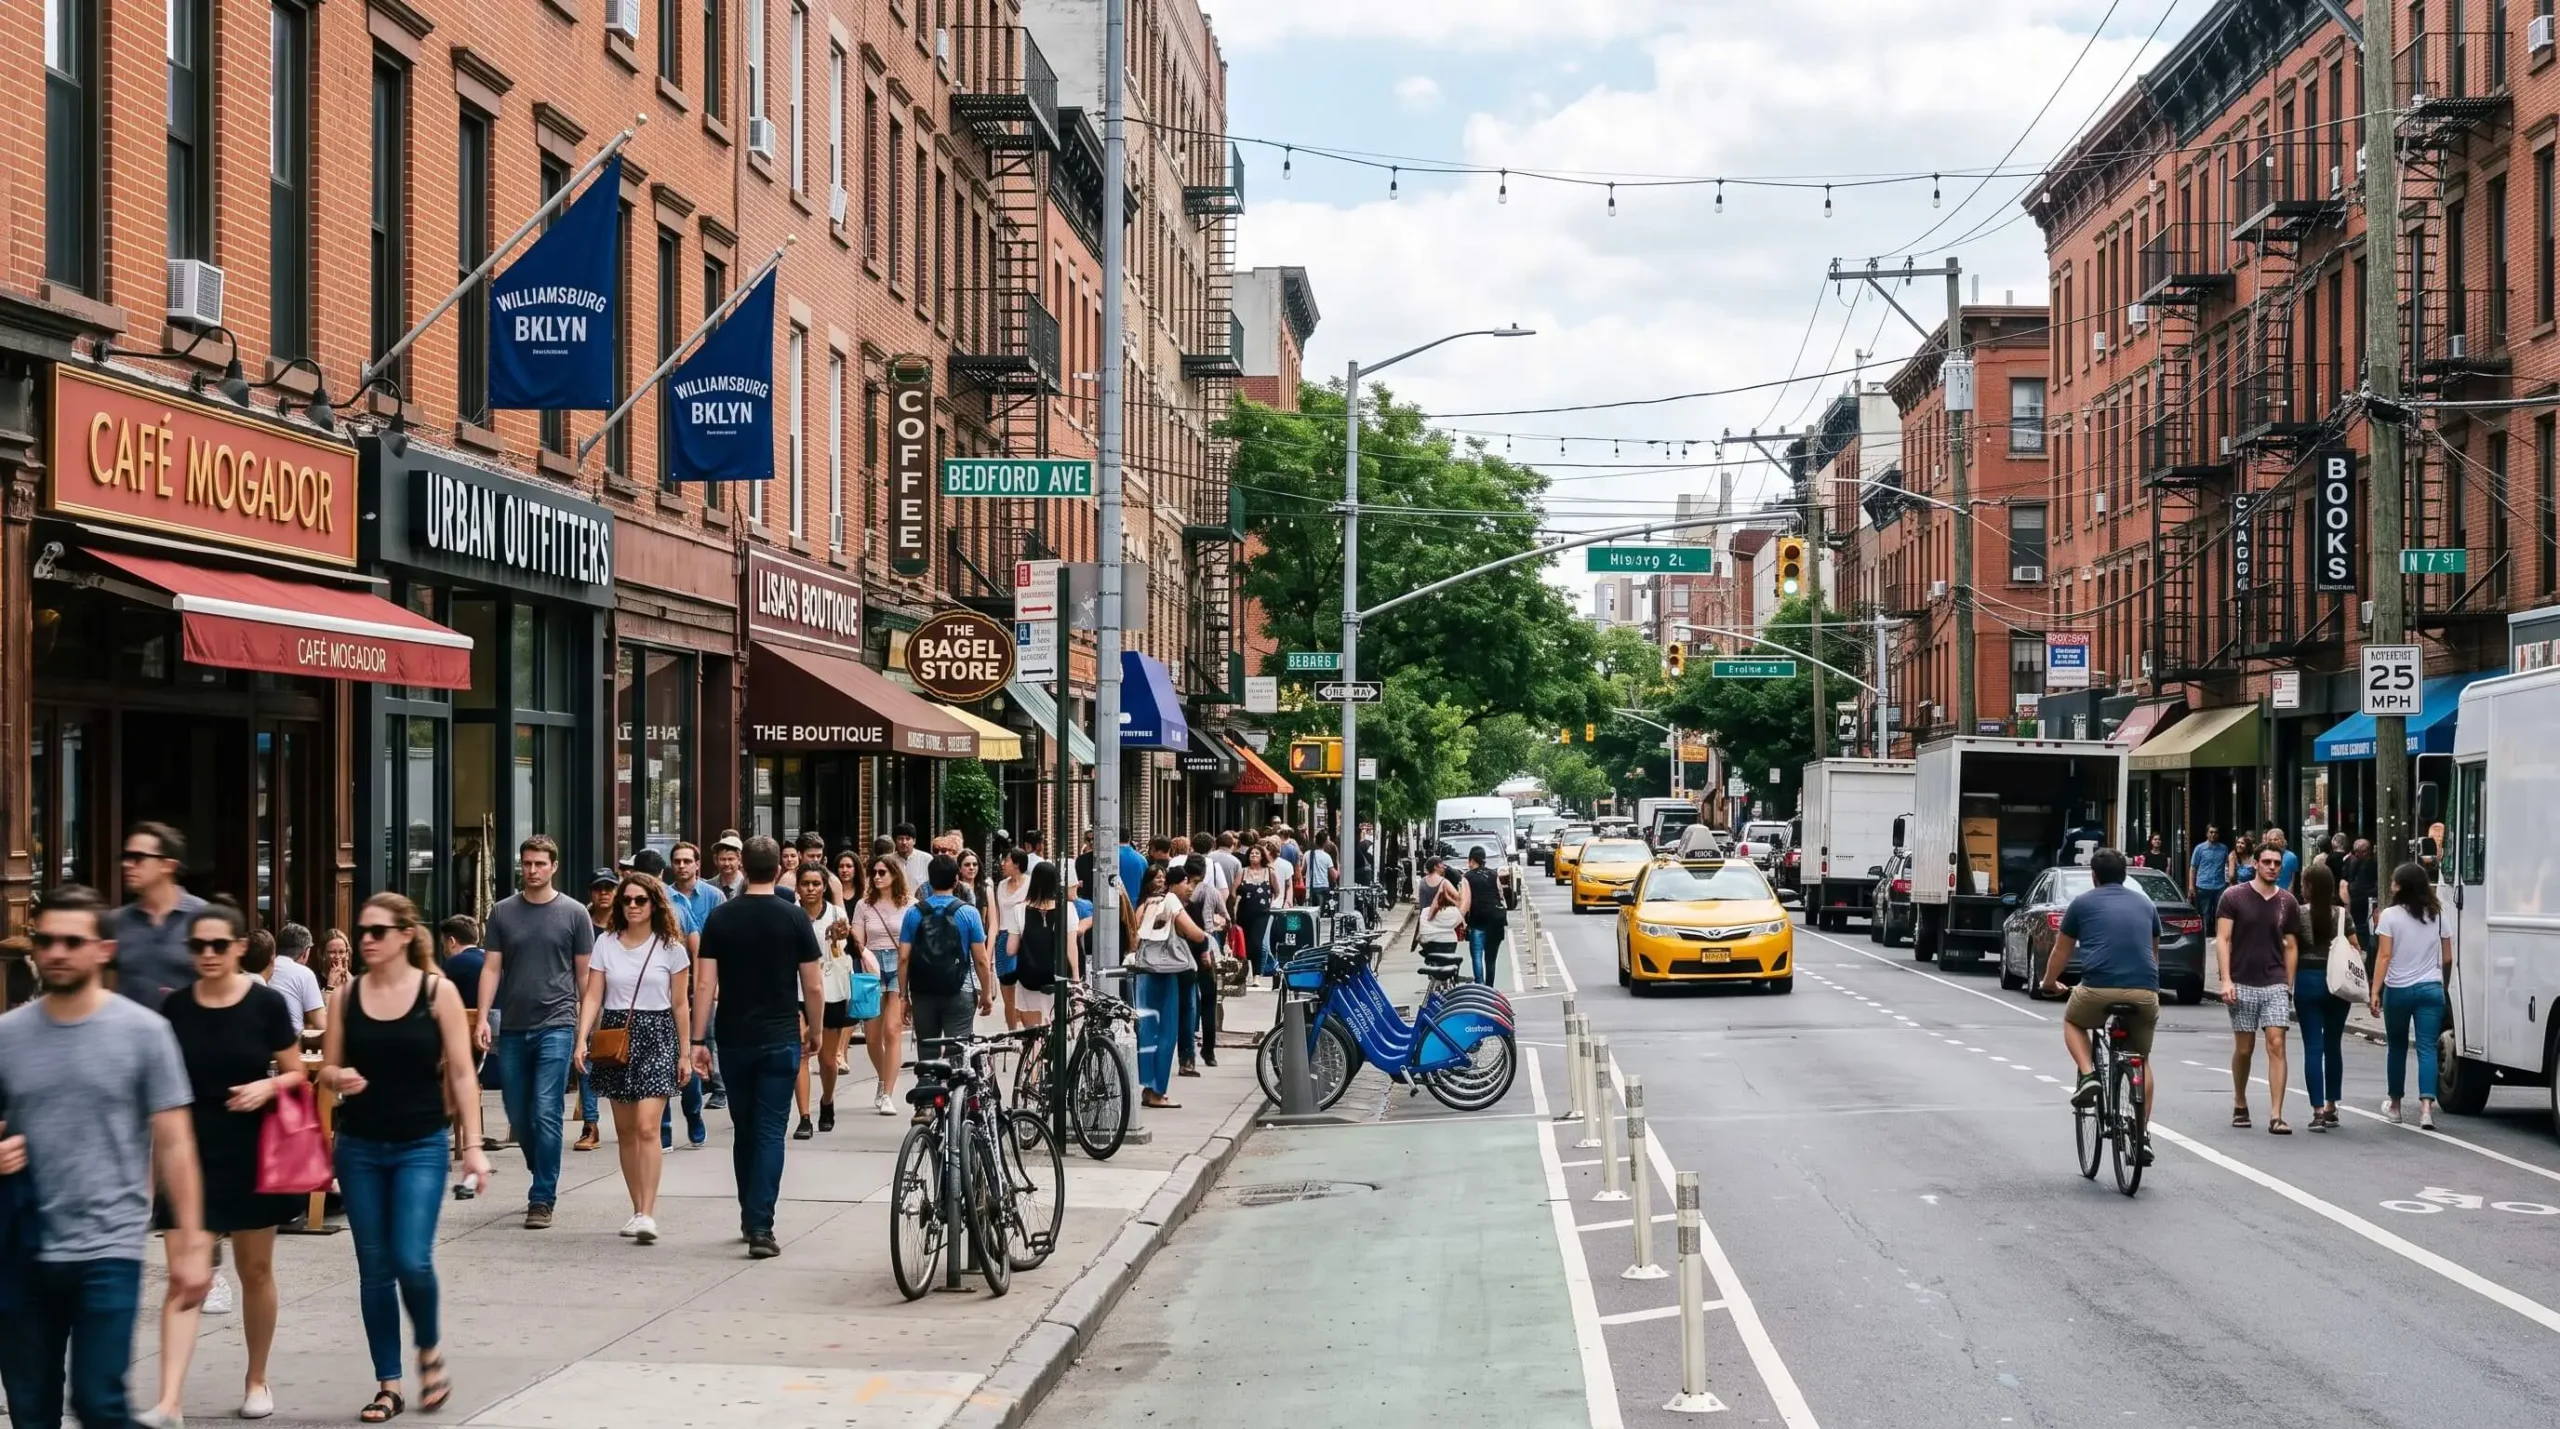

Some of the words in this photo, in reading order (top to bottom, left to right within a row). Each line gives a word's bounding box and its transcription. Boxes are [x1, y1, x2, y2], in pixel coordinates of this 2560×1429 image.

[496, 286, 607, 314] WILLIAMSBURG
[515, 316, 587, 342] BKLYN
[674, 375, 769, 400] WILLIAMSBURG
[691, 401, 753, 424] BKLYN
[88, 411, 174, 498] CAFÉ
[186, 435, 333, 533] MOGADOR
[897, 390, 925, 548] COFFEE
[948, 464, 1040, 492] BEDFORD
[1048, 465, 1086, 492] AVE
[427, 471, 496, 561] URBAN
[504, 494, 609, 587] OUTFITTERS
[2326, 458, 2348, 579] BOOKS
[2409, 552, 2418, 571] N
[2426, 553, 2435, 571] 7
[758, 568, 798, 622] LISA'S
[801, 582, 858, 638] BOUTIQUE
[944, 624, 975, 637] THE
[298, 636, 327, 667] CAFÉ
[330, 642, 387, 673] MOGADOR
[919, 638, 1002, 659] BAGEL
[920, 660, 1000, 680] STORE
[2370, 665, 2414, 690] 25
[2372, 695, 2411, 708] MPH
[753, 725, 788, 741] THE
[792, 725, 883, 742] BOUTIQUE
